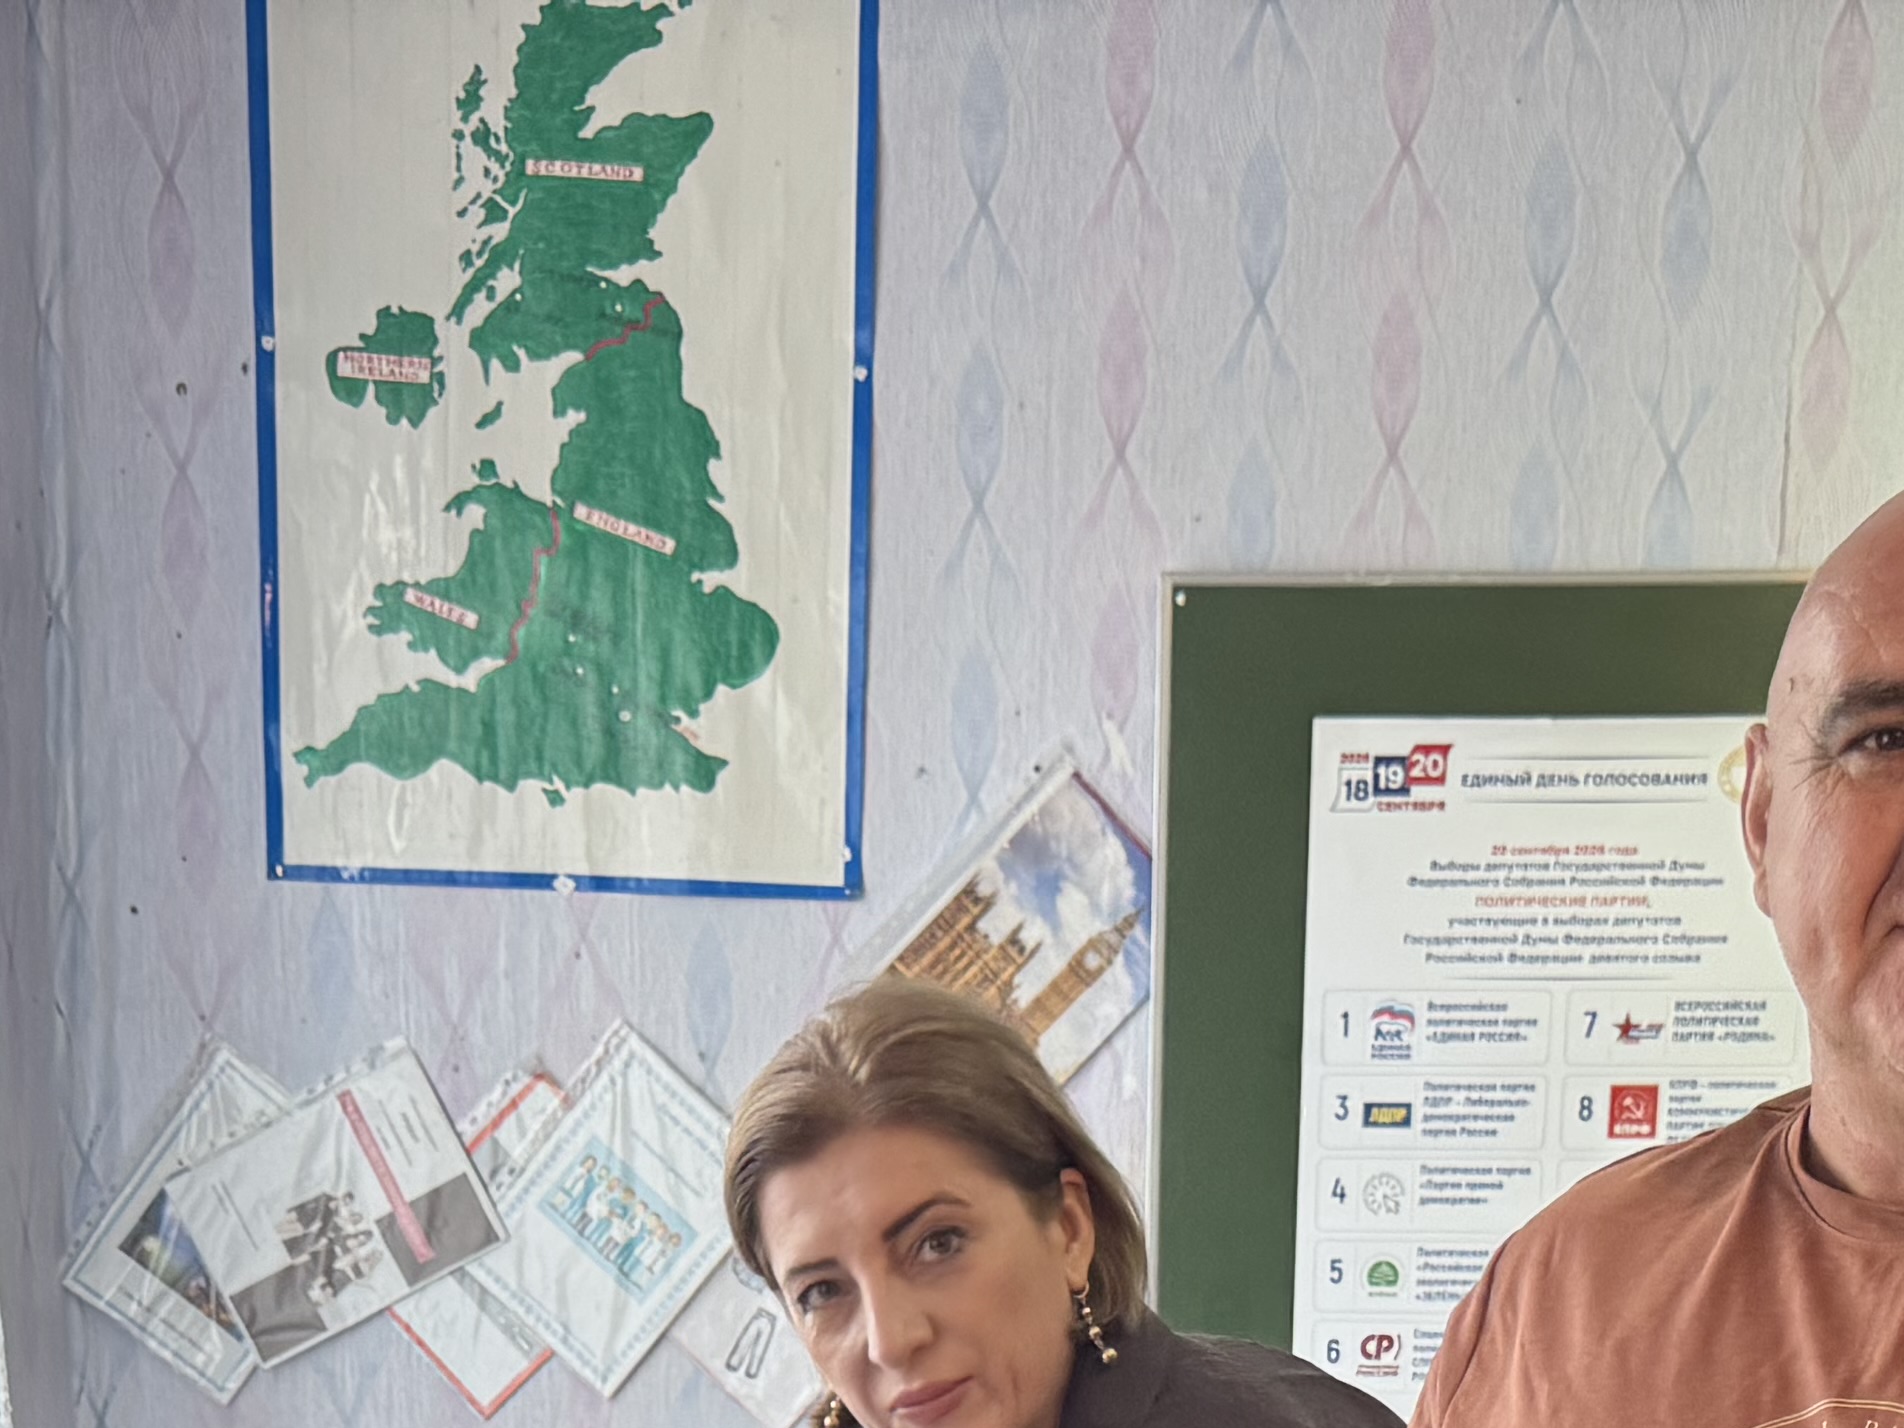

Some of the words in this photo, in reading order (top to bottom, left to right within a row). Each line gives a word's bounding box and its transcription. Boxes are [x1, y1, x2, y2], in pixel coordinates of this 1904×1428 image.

[532, 160, 634, 179] SCOTLAND
[584, 508, 668, 550] ENGLAND
[412, 590, 469, 625] WALES
[1376, 763, 1404, 792] 19
[1409, 752, 1445, 779] 20
[1344, 777, 1369, 802] 18
[1460, 771, 1533, 789] ЕДИНЫЙ
[1535, 772, 1581, 789] ДЕНЬ
[1583, 771, 1709, 788] ГОЛОСОВАНИЯ
[1340, 1010, 1350, 1039] 1
[1583, 1011, 1597, 1039] 7
[1334, 1095, 1349, 1121] 3
[1578, 1096, 1593, 1122] 8
[1331, 1177, 1346, 1204] 4
[1329, 1258, 1343, 1284] 5
[1326, 1338, 1340, 1364] 6
